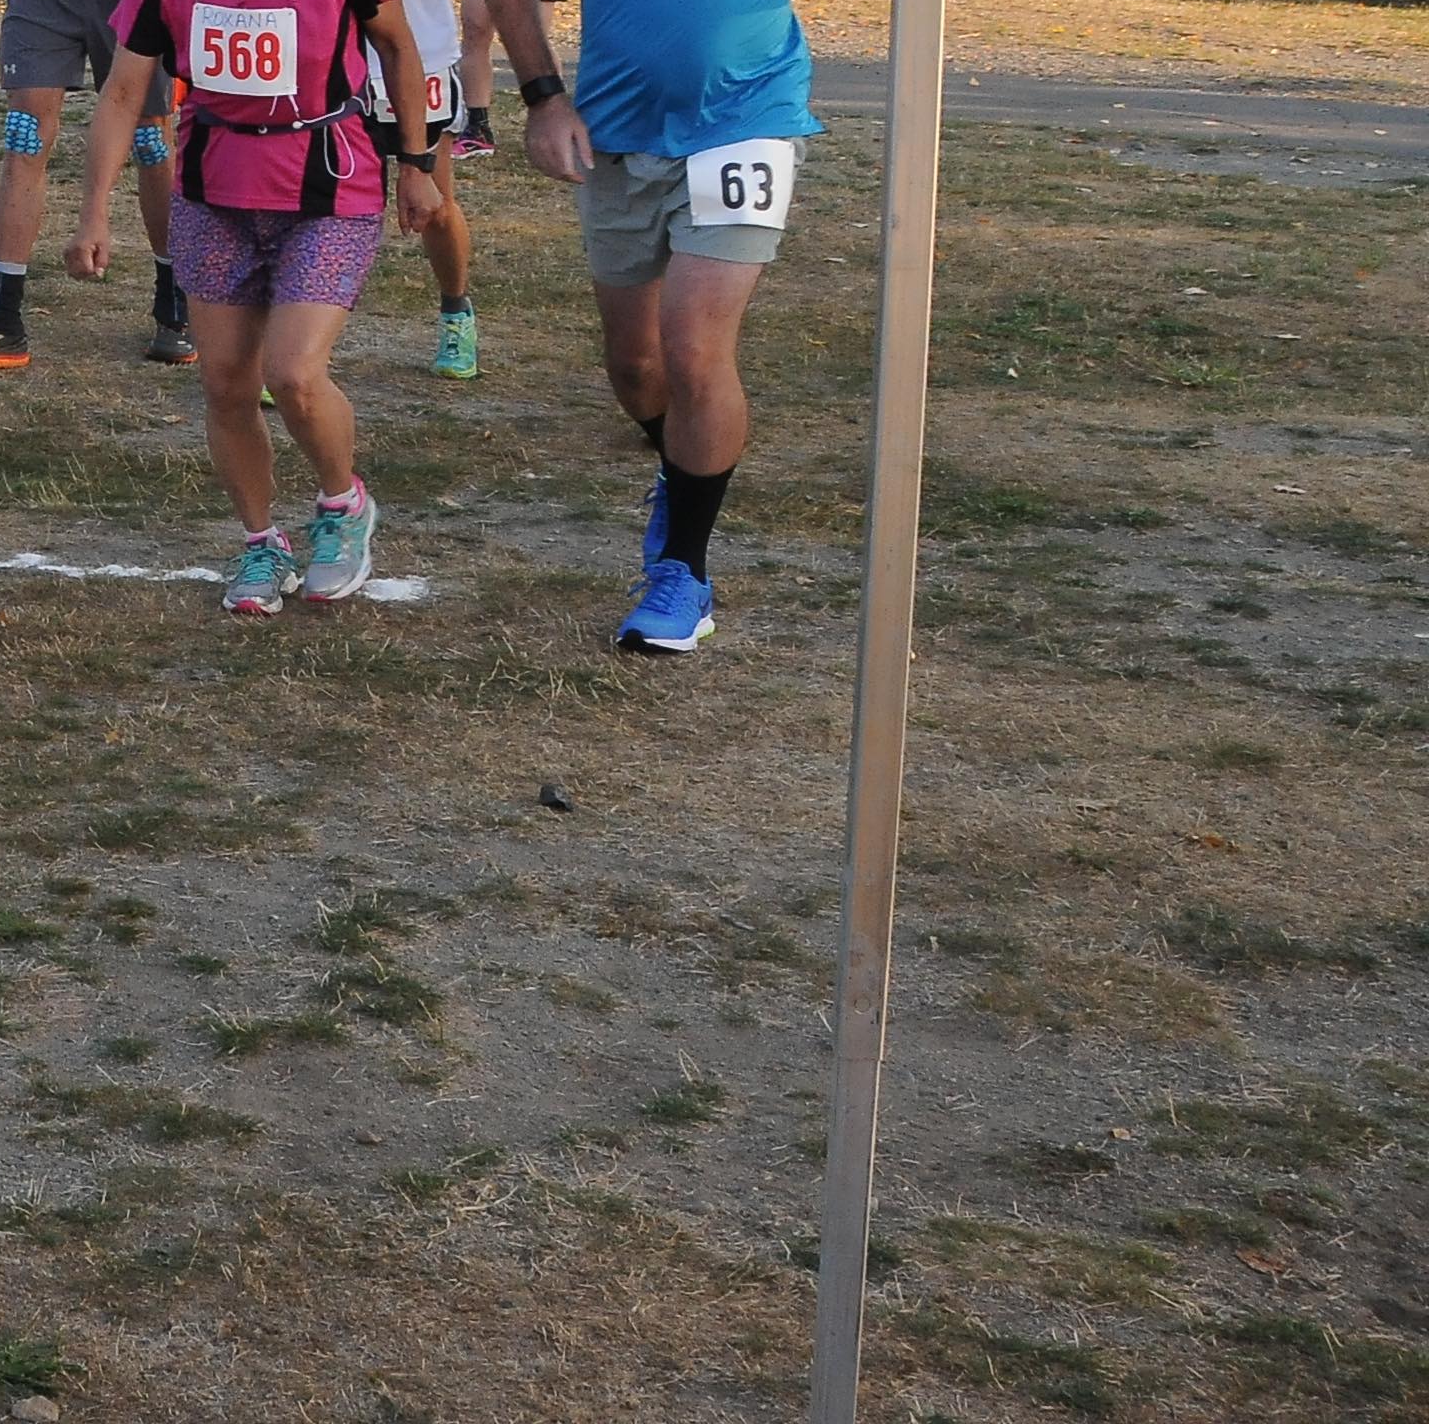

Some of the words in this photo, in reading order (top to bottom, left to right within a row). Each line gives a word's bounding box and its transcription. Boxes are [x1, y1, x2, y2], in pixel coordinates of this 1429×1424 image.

[202, 6, 278, 28] ROXANA
[204, 28, 281, 81] 568
[721, 162, 773, 211] 63
